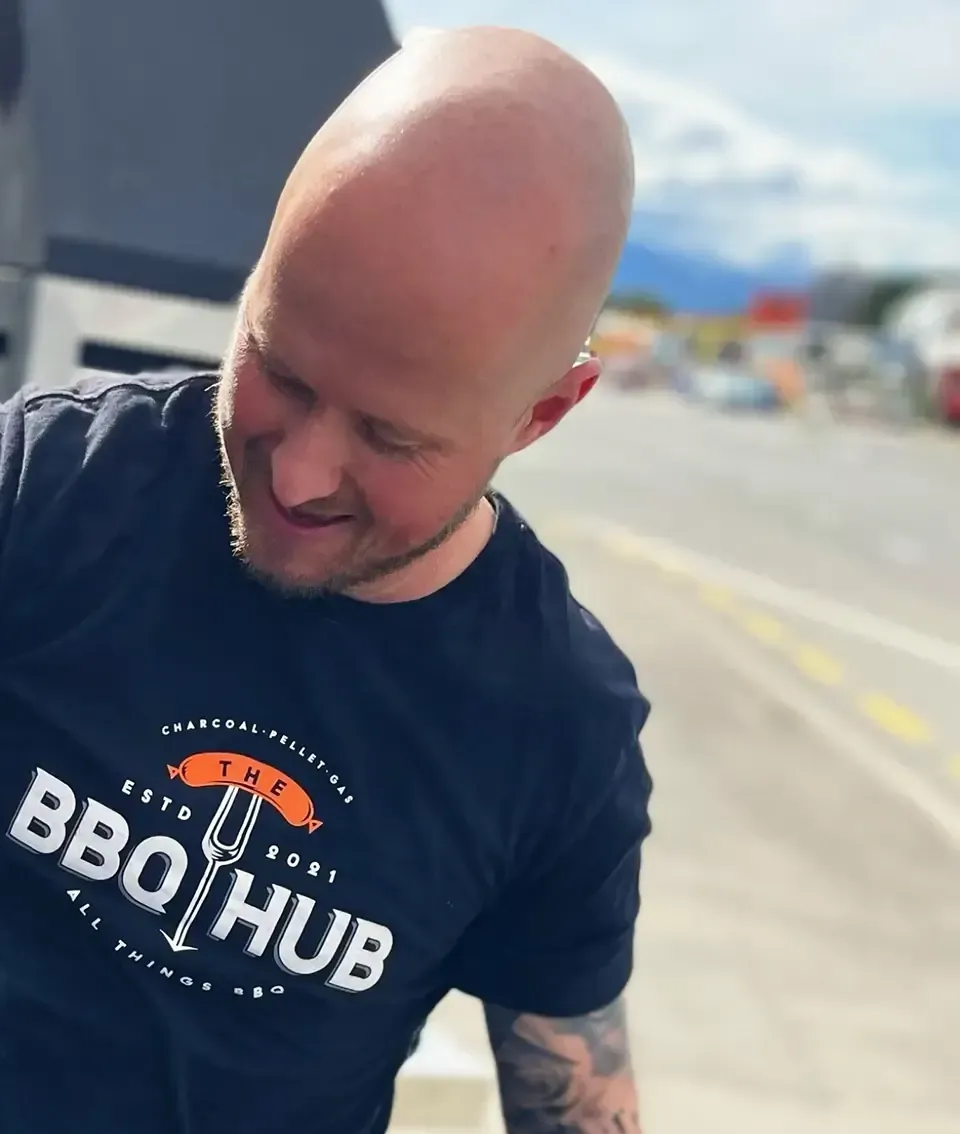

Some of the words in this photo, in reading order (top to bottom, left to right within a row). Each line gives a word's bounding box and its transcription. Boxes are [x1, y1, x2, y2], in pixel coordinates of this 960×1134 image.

[218, 760, 287, 797] THE
[6, 767, 188, 915] BBQ
[207, 868, 393, 993] HUB
[122, 780, 192, 821] ESTD
[265, 845, 337, 883] 2021
[67, 889, 100, 930] ALL
[114, 940, 212, 992] THINGS
